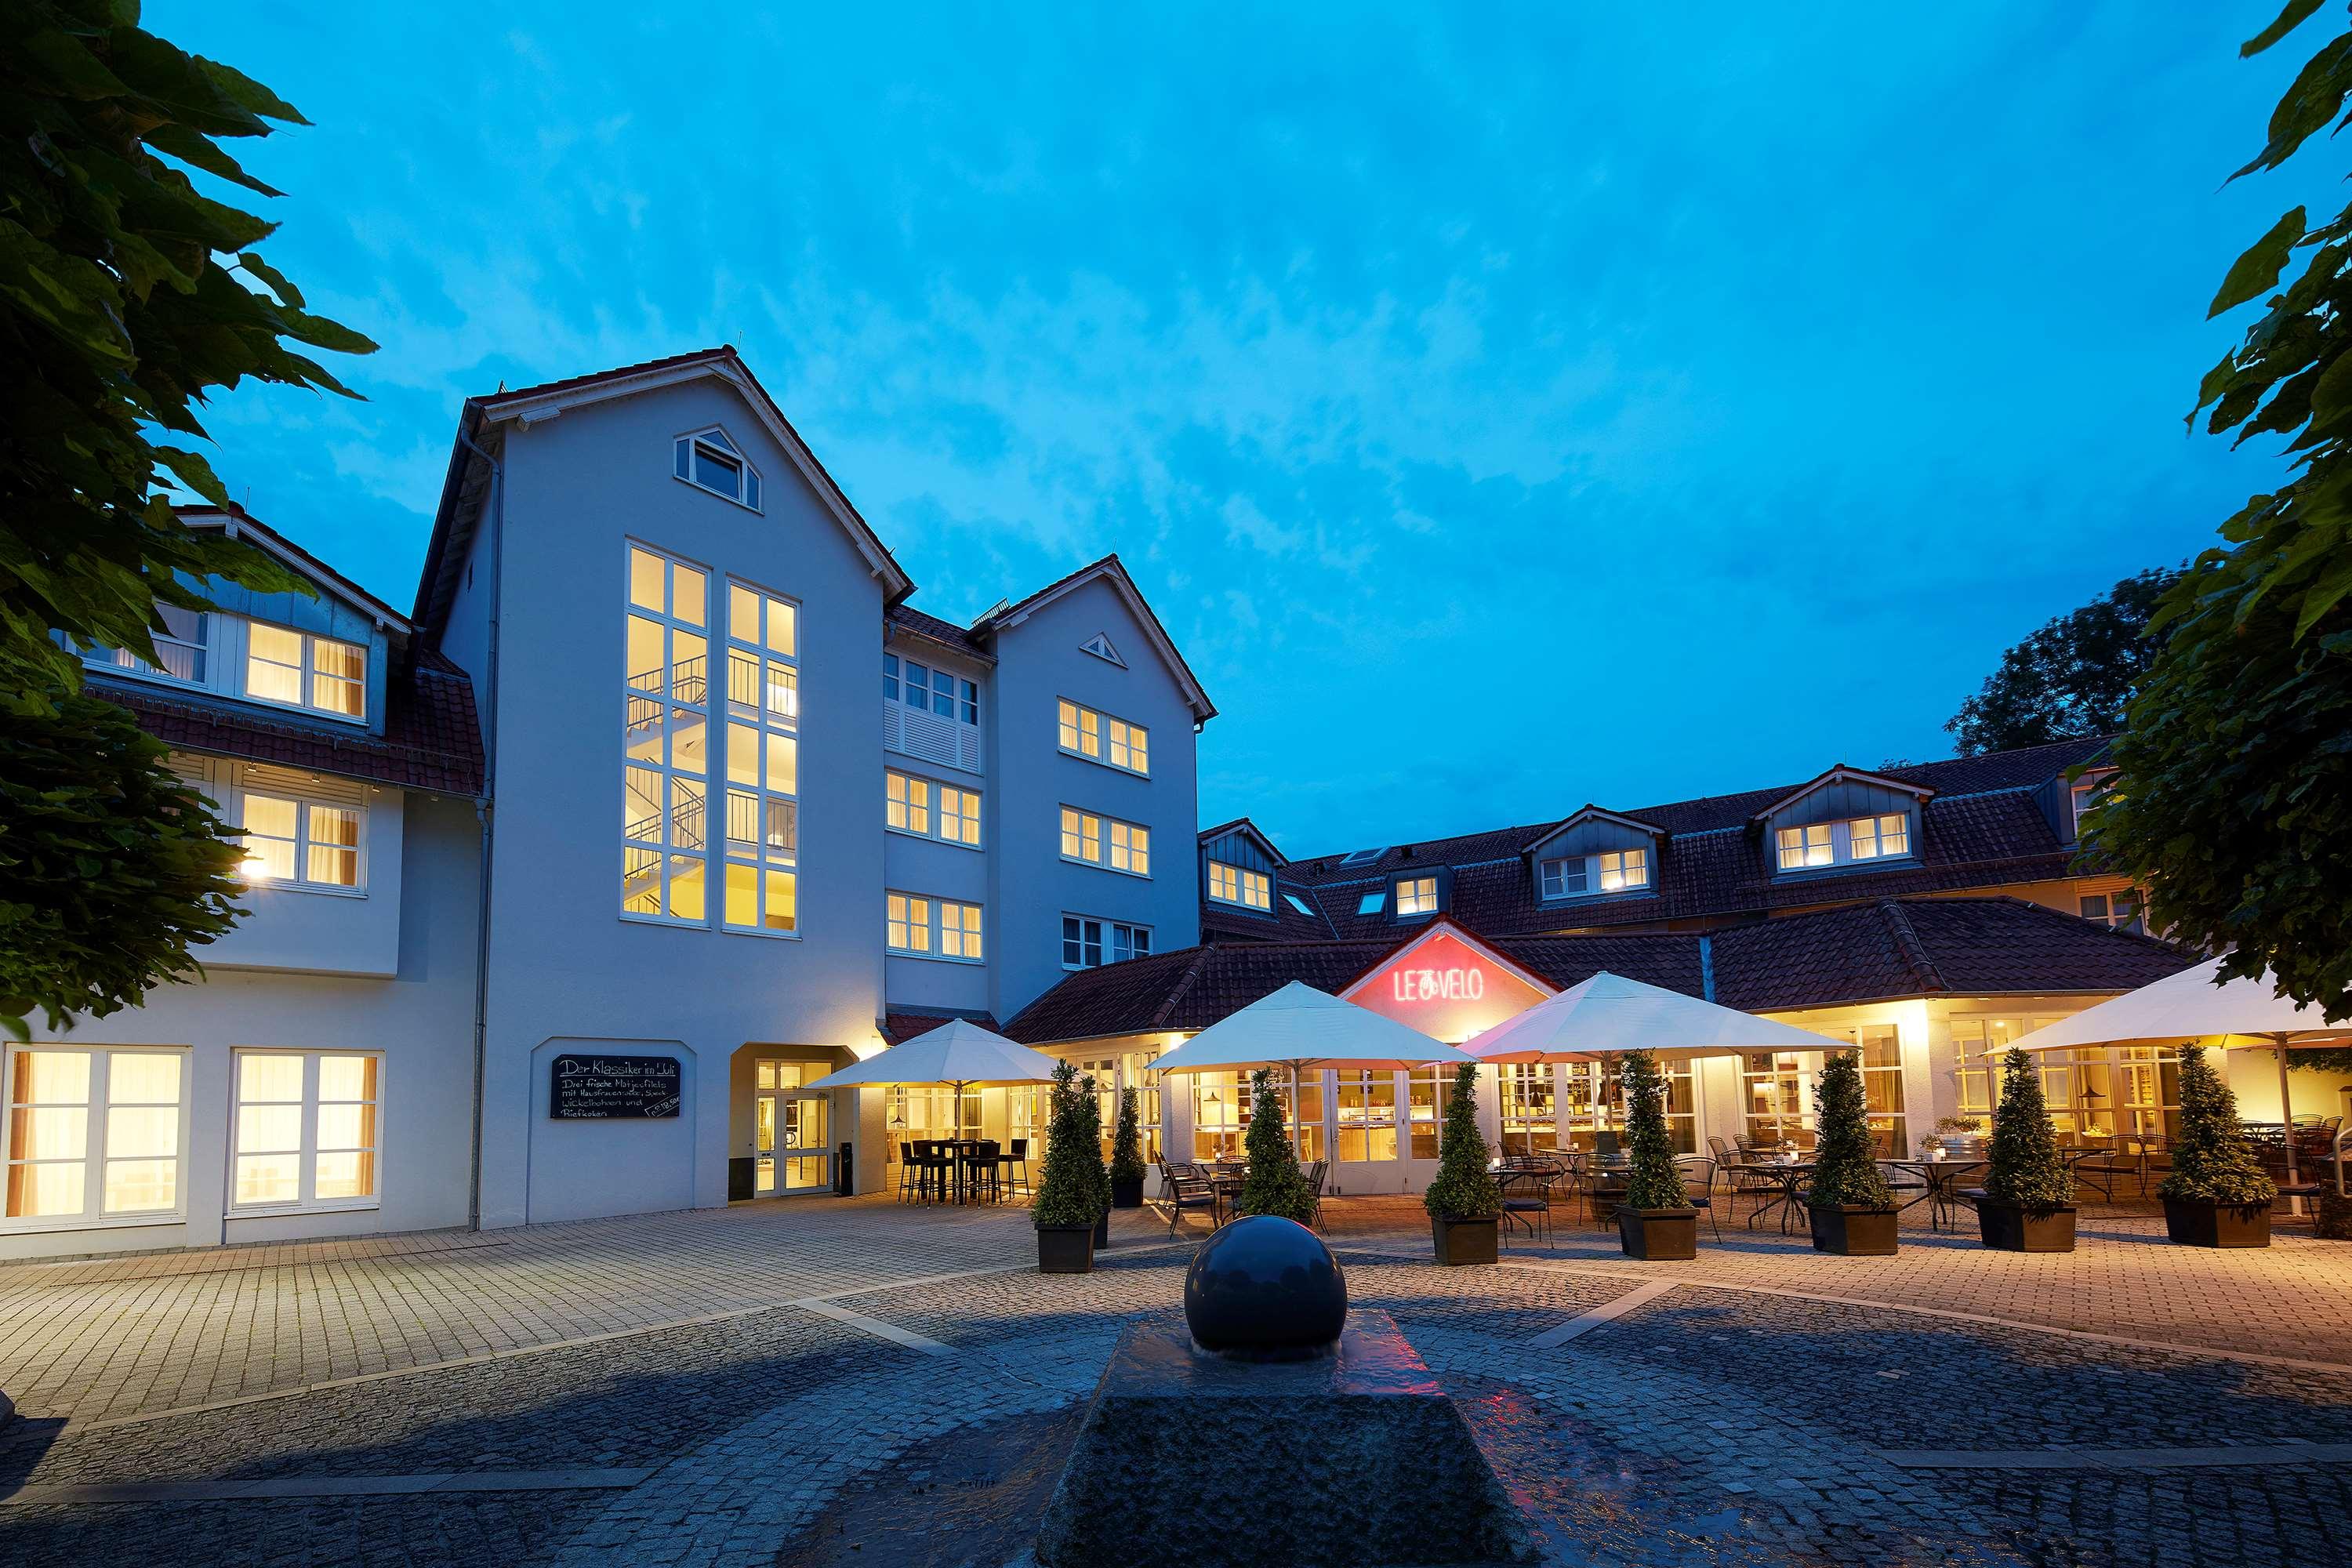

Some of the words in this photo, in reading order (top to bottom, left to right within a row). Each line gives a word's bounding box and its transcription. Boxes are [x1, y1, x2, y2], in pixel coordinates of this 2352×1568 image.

[1437, 968, 1483, 1000] VELO
[559, 1060, 590, 1075] Der
[592, 1060, 641, 1075] Klassiker
[644, 1062, 655, 1074] im
[657, 1062, 675, 1075] Juli
[561, 1079, 583, 1089] Drei
[586, 1078, 612, 1088] frische
